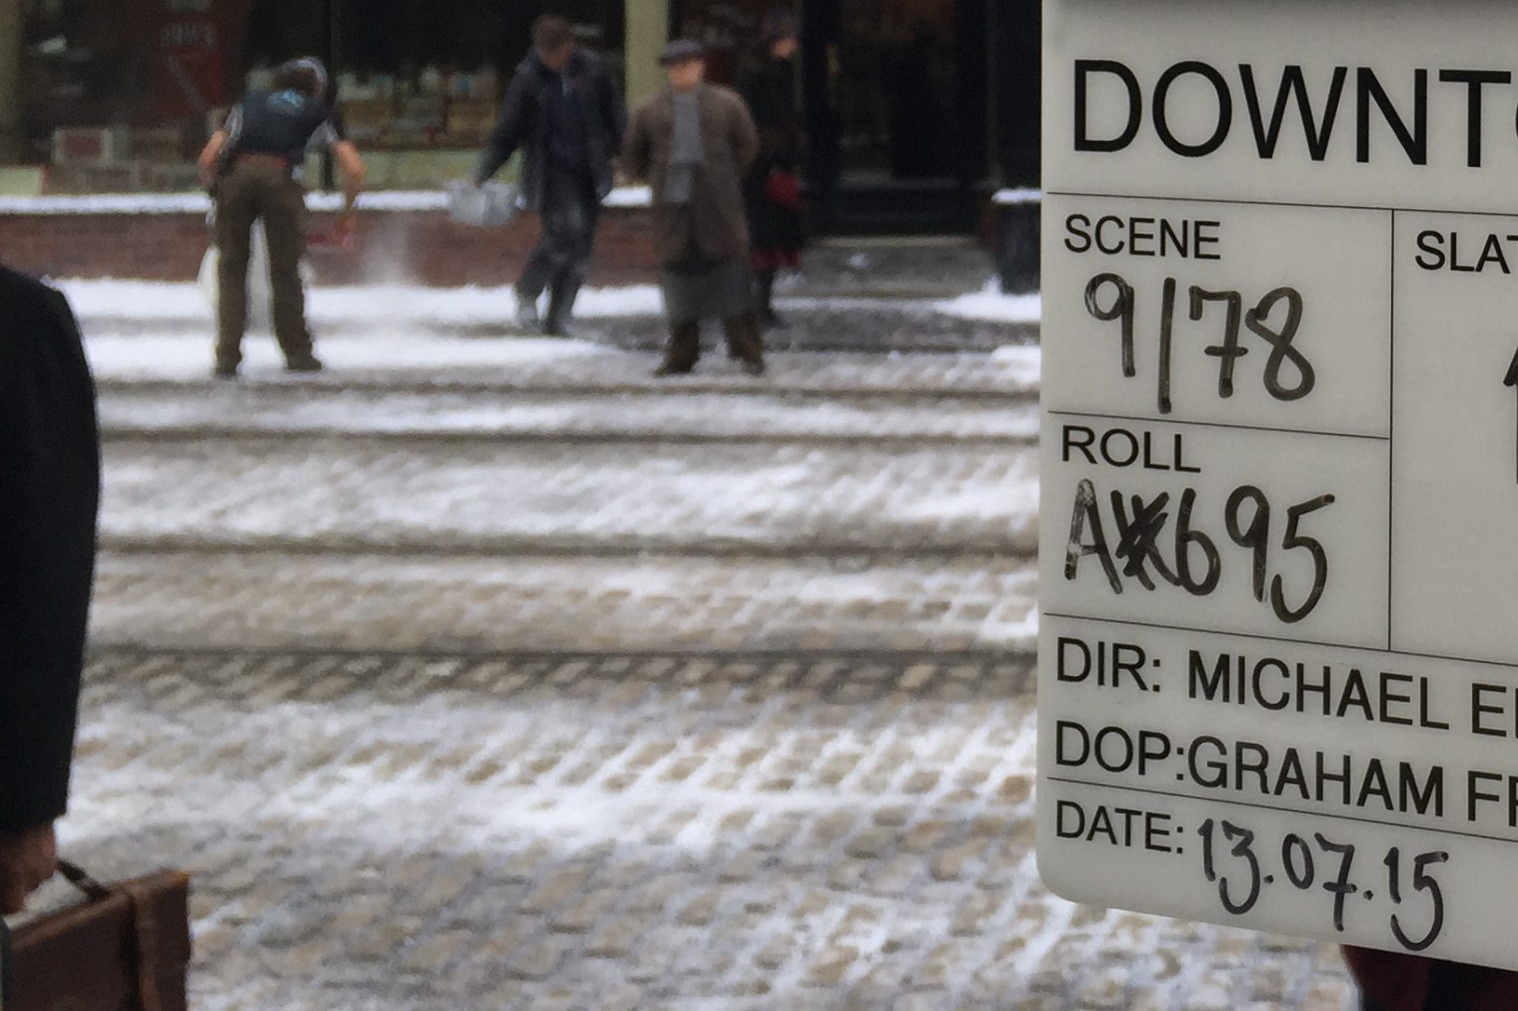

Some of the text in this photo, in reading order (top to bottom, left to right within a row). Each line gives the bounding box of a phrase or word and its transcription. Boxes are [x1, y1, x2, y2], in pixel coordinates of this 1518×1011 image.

[1064, 213, 1221, 260] SCENE
[1062, 425, 1202, 474] ROLL
[1057, 636, 1161, 693] DIR:
[1188, 649, 1450, 731] MICHAEL
[1056, 800, 1184, 854] DATE:
[1197, 817, 1449, 951] 13.07.15
